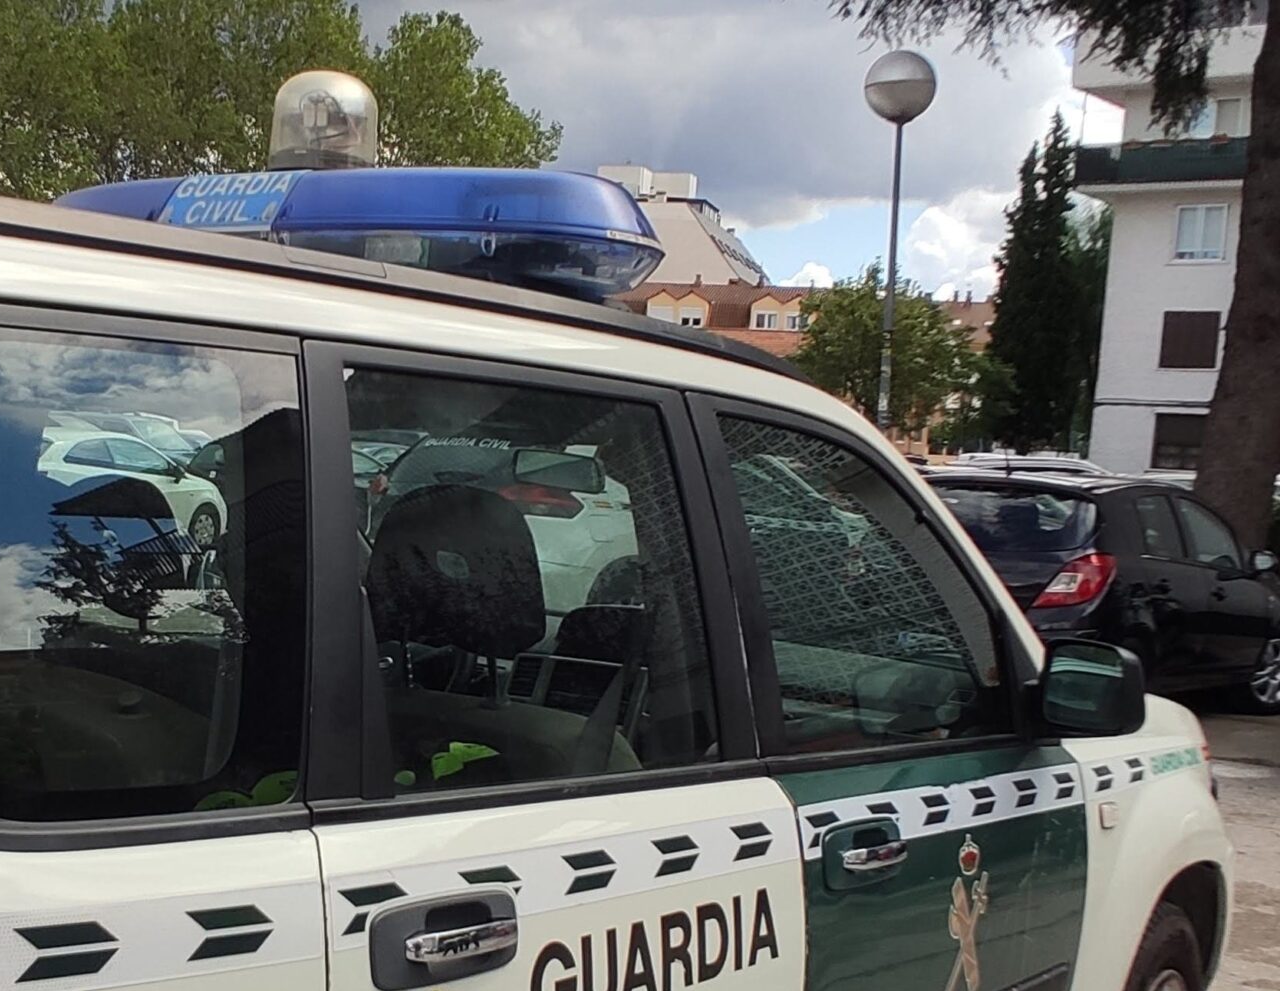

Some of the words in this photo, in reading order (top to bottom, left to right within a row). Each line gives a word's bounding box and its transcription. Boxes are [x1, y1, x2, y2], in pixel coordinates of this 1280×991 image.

[177, 174, 293, 198] GUARDIA
[185, 201, 249, 224] CIVIL
[425, 437, 477, 447] GUARDIA
[478, 438, 512, 450] CIVIL
